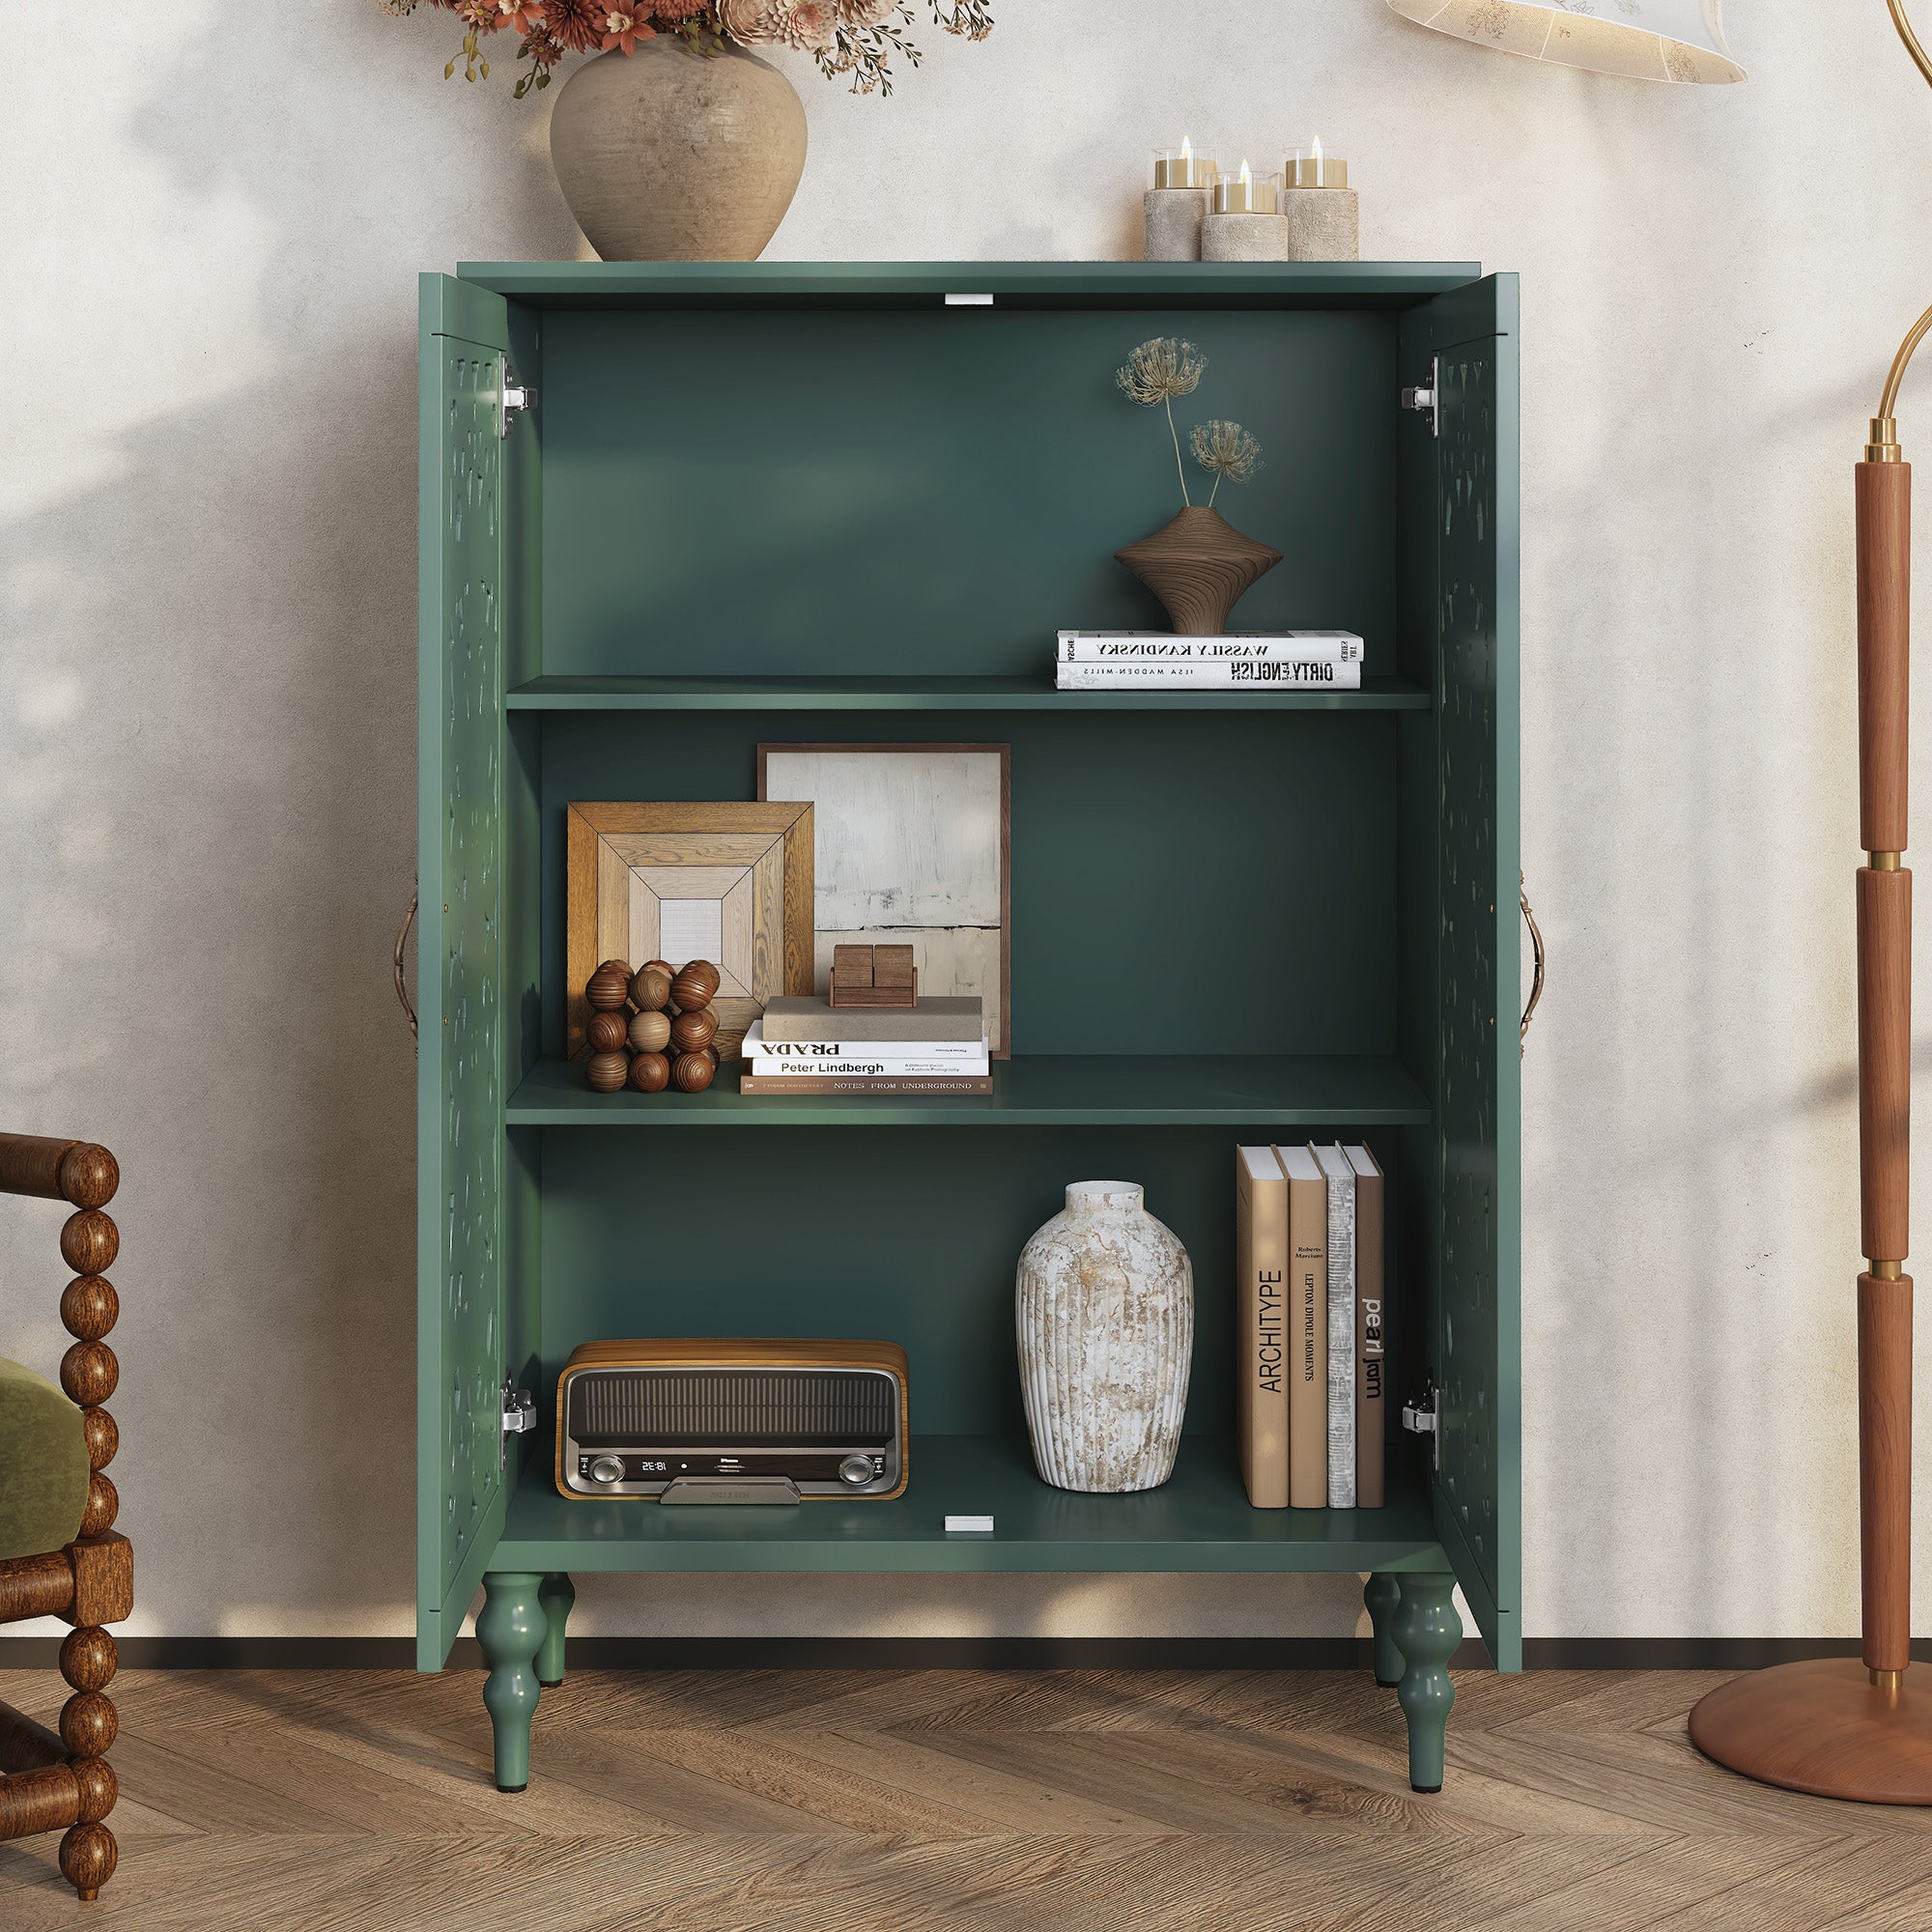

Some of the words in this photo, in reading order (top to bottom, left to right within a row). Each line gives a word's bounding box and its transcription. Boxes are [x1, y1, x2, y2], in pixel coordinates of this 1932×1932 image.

[760, 1043, 839, 1056] PRADA
[781, 1063, 814, 1072] Peter
[818, 1063, 884, 1074] Lindbergh
[1304, 1273, 1314, 1305] LEPTON
[1259, 1269, 1282, 1393] ARCHITYPE
[1305, 1307, 1314, 1338] DIPOLE
[1362, 1297, 1384, 1353] pearl
[1305, 1339, 1314, 1382] MOMENTS
[1362, 1358, 1384, 1399] jam
